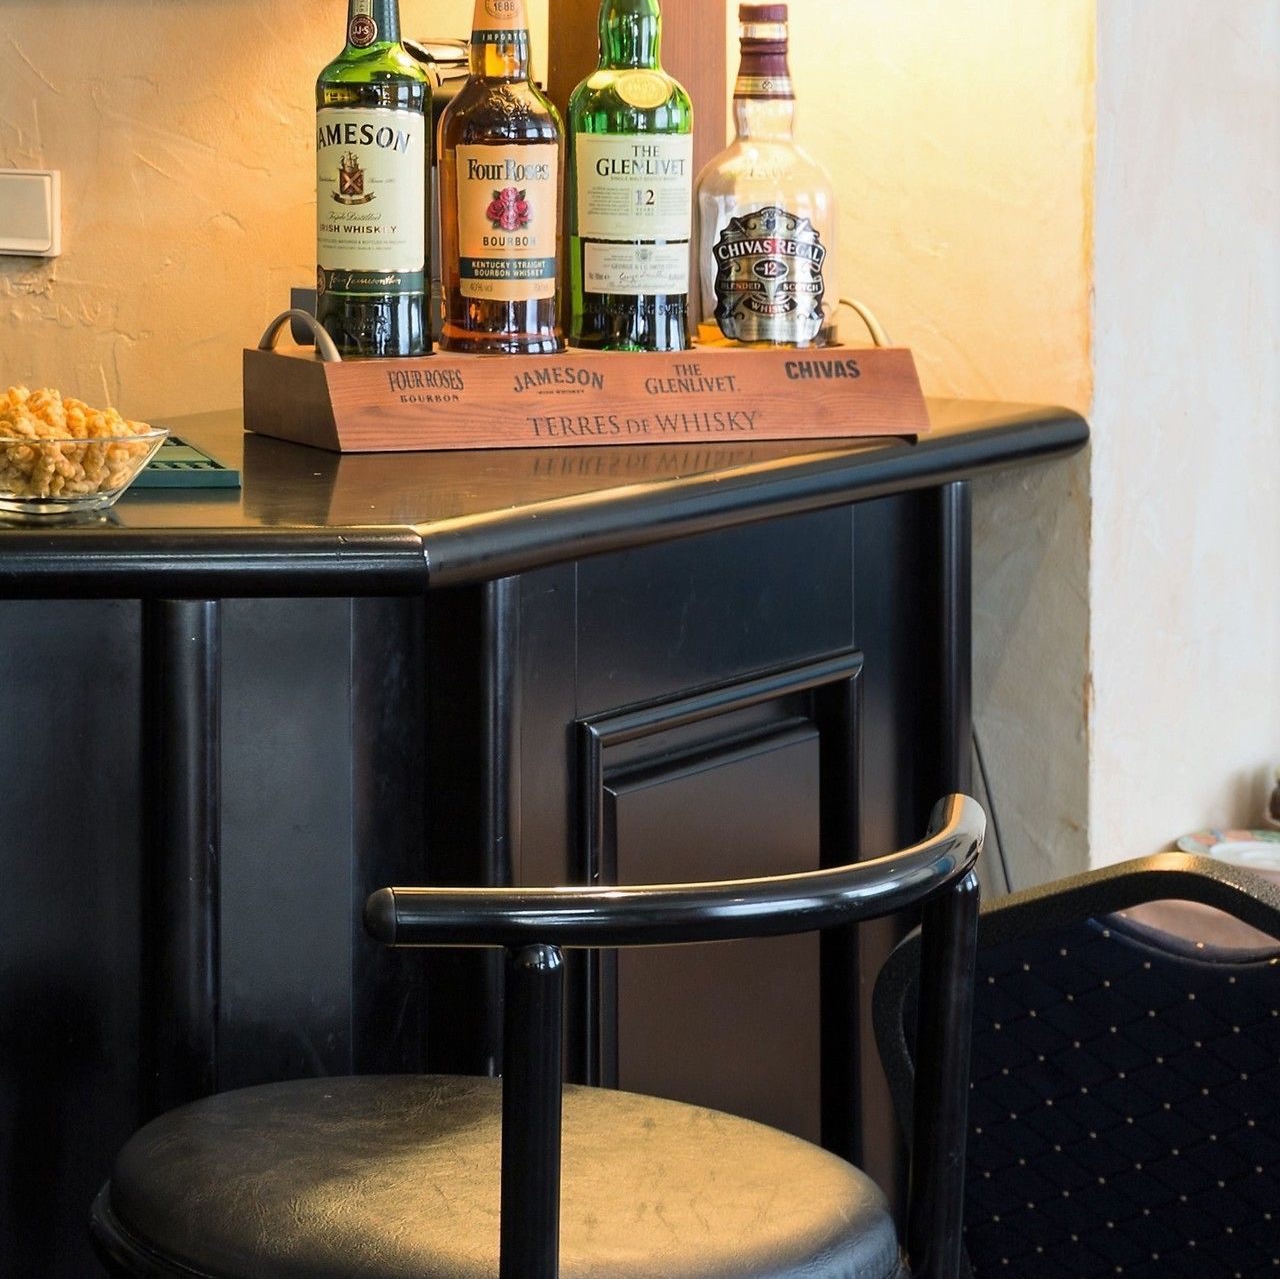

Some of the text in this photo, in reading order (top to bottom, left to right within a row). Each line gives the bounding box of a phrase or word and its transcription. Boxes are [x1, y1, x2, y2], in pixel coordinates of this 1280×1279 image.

[317, 123, 410, 154] AMESON
[631, 145, 660, 157] THE
[468, 159, 549, 182] Four Roses
[596, 158, 685, 176] GLENLIVET
[636, 189, 655, 205] 12
[319, 224, 340, 233] RISH
[483, 237, 536, 246] BOURBON
[719, 240, 820, 262] CHIVAS REGAL
[472, 261, 546, 269] KENTUCKY STRAIGHT
[764, 262, 777, 275] 12
[474, 269, 544, 277] BOURBON WHISKEY
[783, 283, 819, 291] SCOTCH
[751, 301, 791, 313] WHISKY
[672, 364, 701, 376] THE
[784, 359, 861, 380] CHIVAS
[388, 368, 464, 392] FOUR ROSES
[513, 367, 604, 393] JAMESON
[645, 375, 736, 395] GLENLIVET
[400, 394, 460, 403] BOURBON
[526, 411, 758, 437] TERRES DE WHISKY
